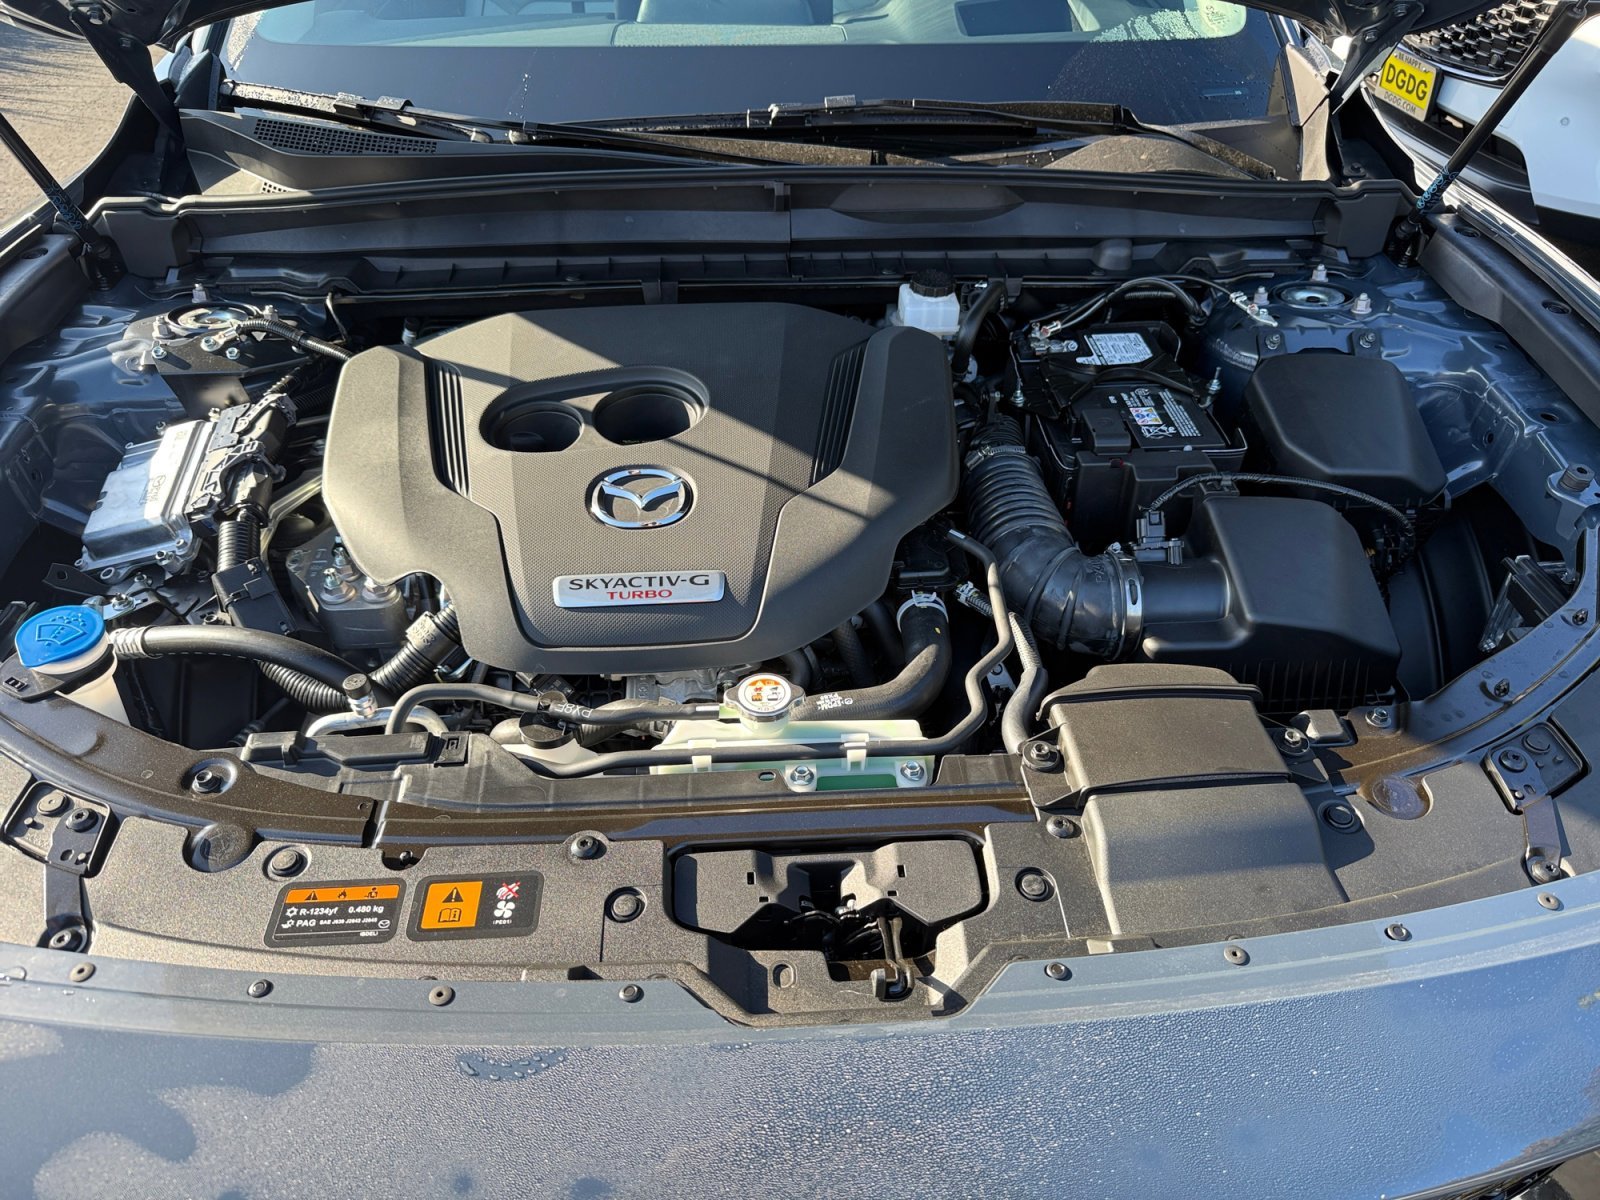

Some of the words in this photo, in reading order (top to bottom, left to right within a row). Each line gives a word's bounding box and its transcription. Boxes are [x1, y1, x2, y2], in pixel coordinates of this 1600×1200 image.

[1385, 63, 1428, 101] DGDG
[1384, 91, 1417, 114] DGDG.COM
[569, 574, 710, 591] SKYACTIV-G
[606, 589, 673, 600] TURBO
[299, 906, 339, 916] R-1234yf
[348, 905, 371, 914] 0.480
[373, 904, 385, 914] kg
[296, 919, 317, 928] PAG
